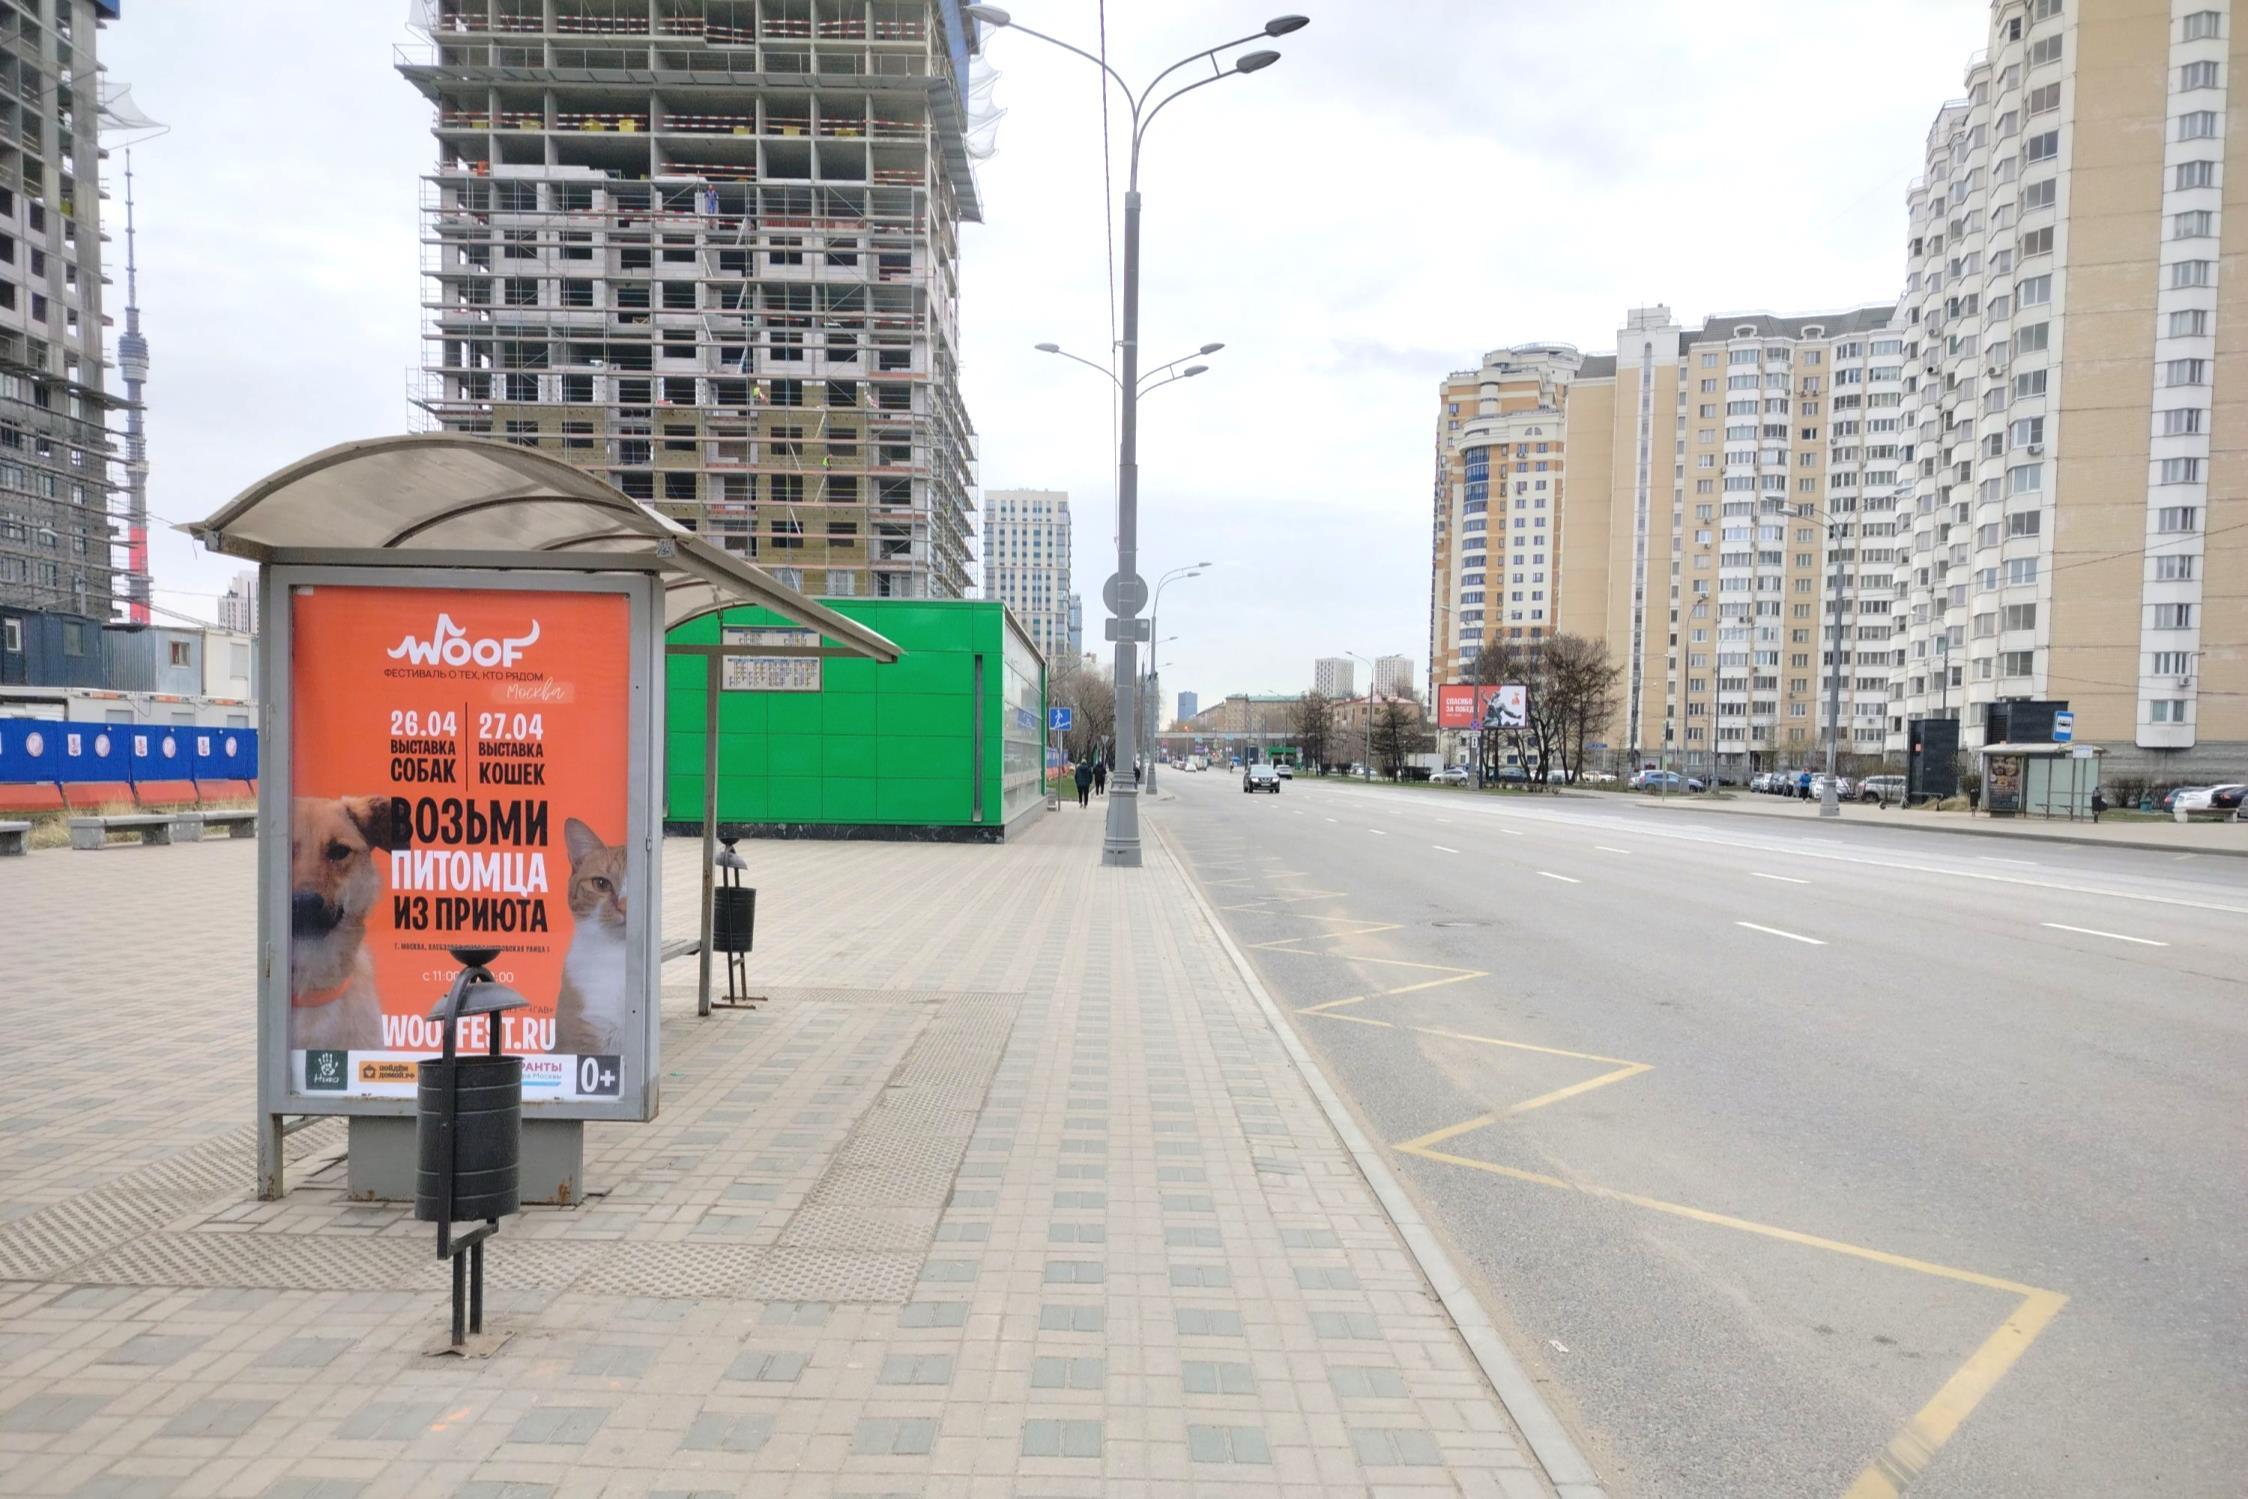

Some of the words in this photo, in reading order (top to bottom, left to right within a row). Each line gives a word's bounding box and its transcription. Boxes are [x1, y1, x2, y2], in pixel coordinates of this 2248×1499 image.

[387, 613, 541, 668] WOOF
[384, 668, 447, 680] ФЕСТИВАЛЬ
[448, 670, 457, 680] О
[460, 670, 480, 682] ТЕХ,
[482, 671, 504, 681] КТО
[505, 671, 544, 683] РЯДОМ
[390, 710, 457, 737] 26.04
[479, 712, 544, 740] 27.04
[390, 739, 457, 755] ВЫСТАВКА
[478, 742, 545, 757] ВЫСТАВКА
[390, 757, 457, 783] СОБАК
[479, 761, 545, 785] КОШЕК
[391, 796, 549, 847] ВОЗЬМИ
[391, 849, 549, 898] ПИТОМЦА
[394, 896, 429, 930] ИЗ
[435, 897, 549, 933] ПРИЮТА
[382, 1014, 556, 1051] WOOFET.RU
[519, 1062, 562, 1073] РАНТЫ
[581, 1057, 616, 1093] 0+
